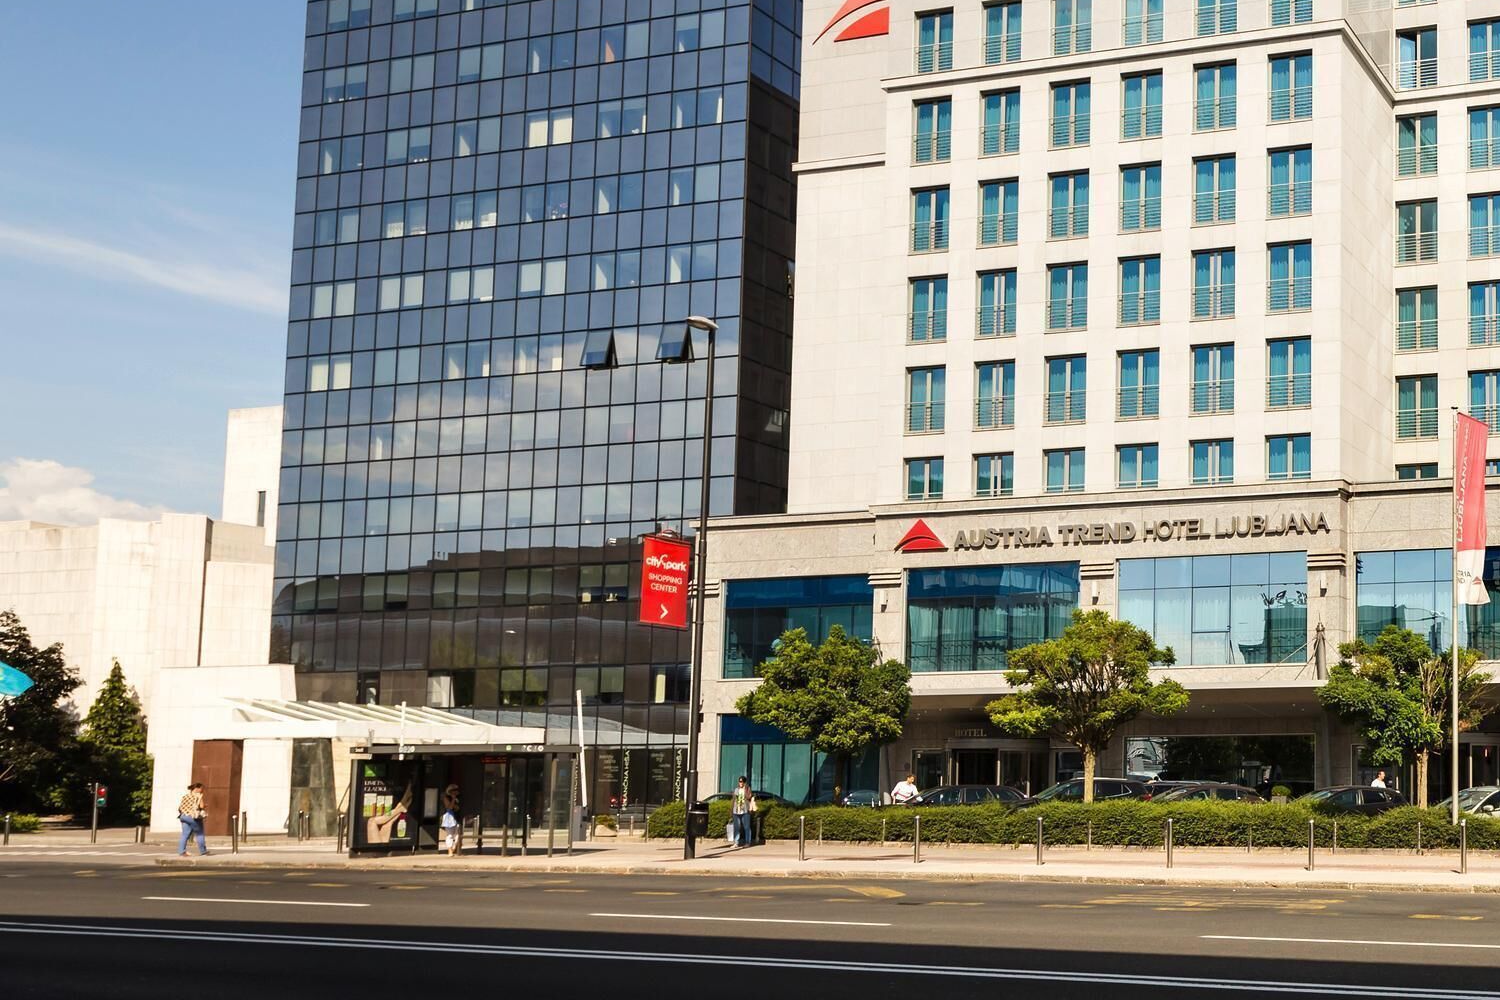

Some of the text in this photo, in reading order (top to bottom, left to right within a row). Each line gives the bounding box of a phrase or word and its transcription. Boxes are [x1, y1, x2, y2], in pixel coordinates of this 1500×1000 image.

[954, 512, 1330, 551] AUSTRIA TREND HOTEL LJUBLJANA
[648, 573, 683, 584] SHOPPING
[651, 583, 677, 593] CENTER
